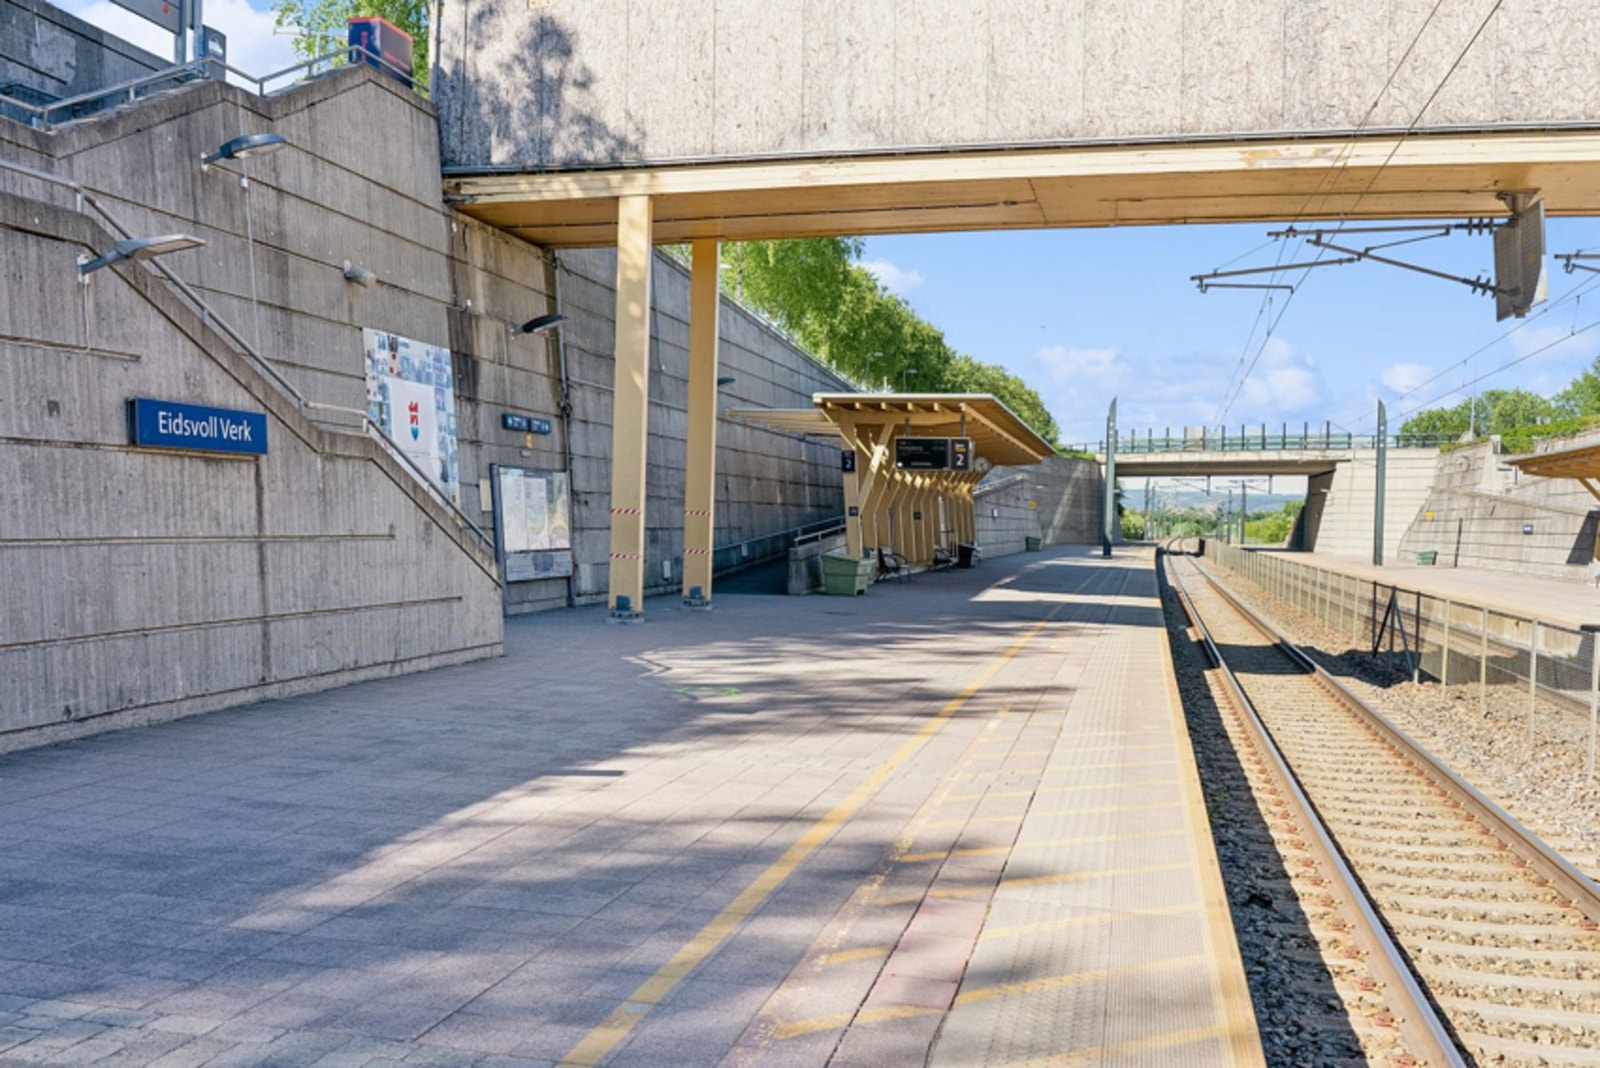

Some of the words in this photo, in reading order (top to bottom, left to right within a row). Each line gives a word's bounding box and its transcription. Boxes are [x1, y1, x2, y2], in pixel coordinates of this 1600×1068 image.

[158, 411, 218, 438] Eidsvoll
[219, 418, 252, 441] Verk
[845, 458, 852, 469] 2
[956, 453, 965, 466] 2
